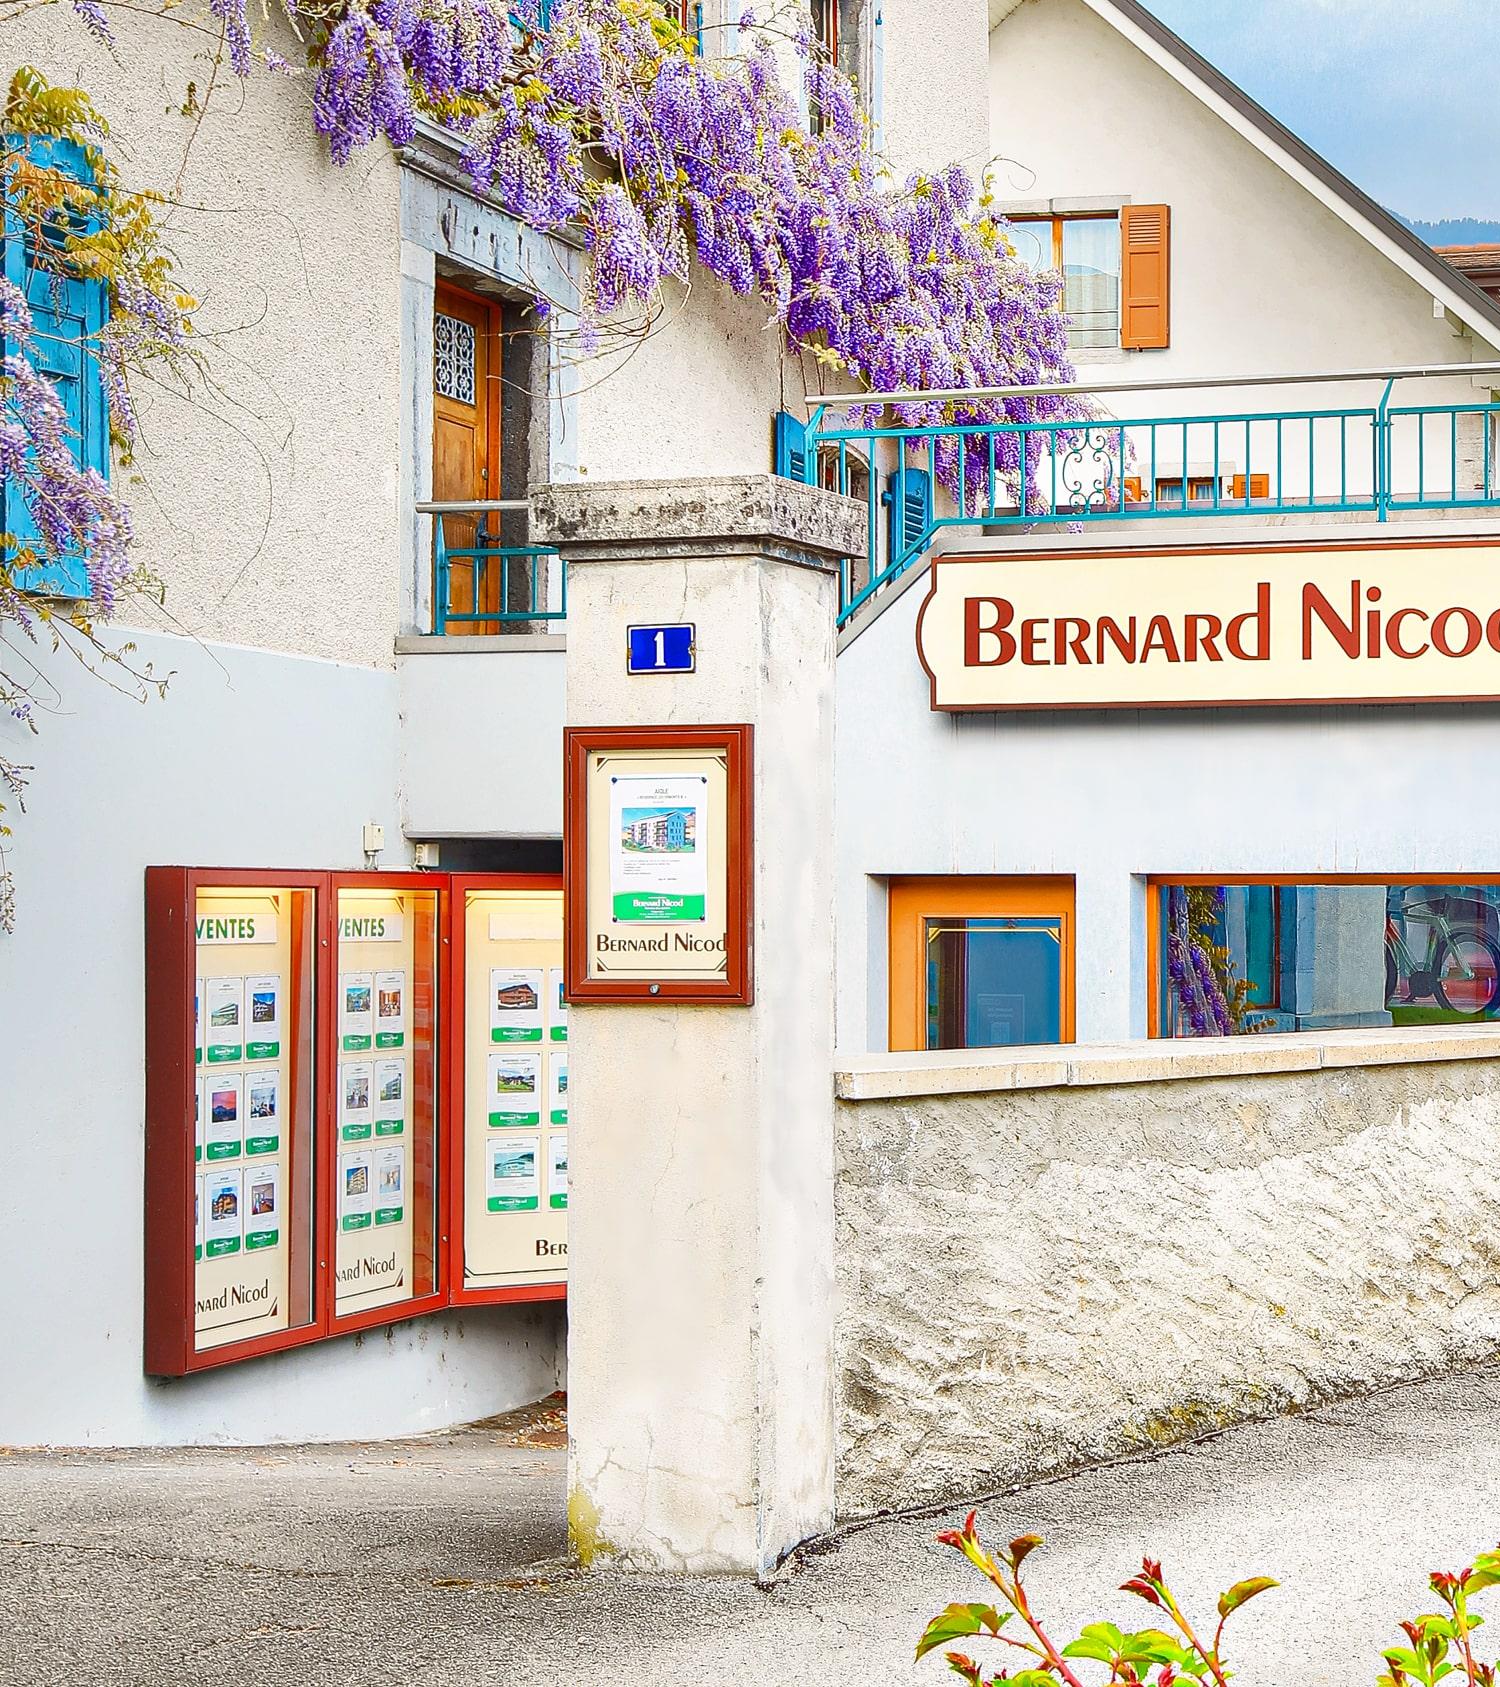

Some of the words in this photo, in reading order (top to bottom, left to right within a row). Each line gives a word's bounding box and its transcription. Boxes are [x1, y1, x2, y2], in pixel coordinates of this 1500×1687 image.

[964, 582, 1271, 667] BERNARd
[654, 631, 666, 666] 1
[195, 918, 255, 939] VENTES
[596, 932, 668, 952] BERNARd
[675, 932, 727, 952] Nicod
[536, 1239, 568, 1256] BER
[363, 1251, 395, 1277] Nicod
[231, 1278, 268, 1307] Nicod
